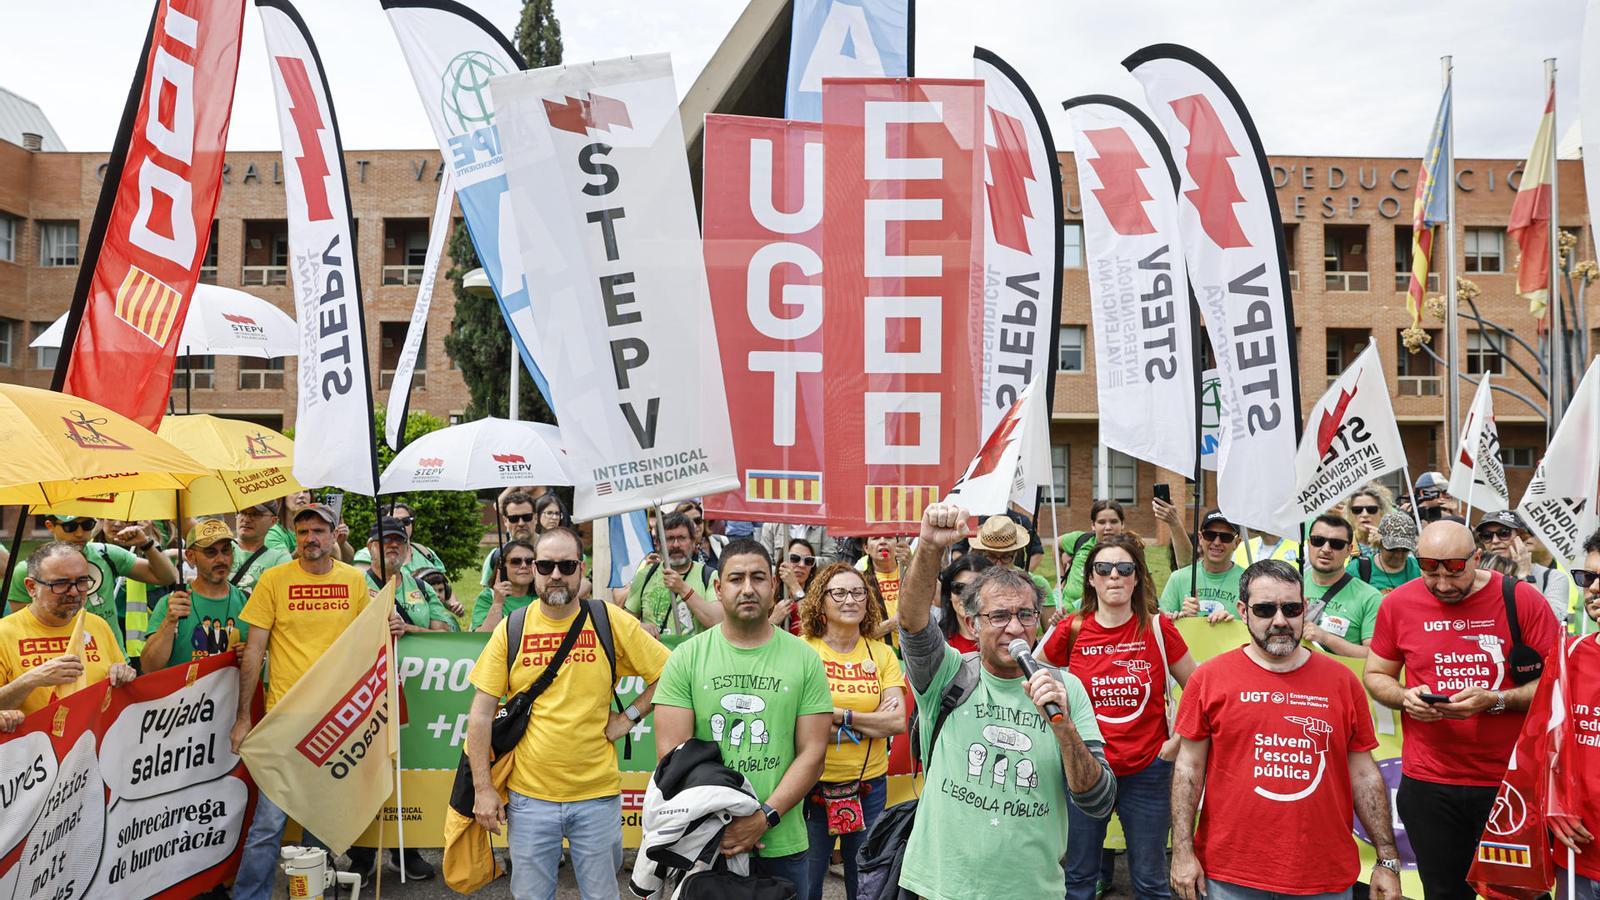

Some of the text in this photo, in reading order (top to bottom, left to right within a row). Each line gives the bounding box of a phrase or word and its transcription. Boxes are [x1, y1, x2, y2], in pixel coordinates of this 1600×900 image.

[1294, 195, 1400, 219] ESPO
[864, 101, 943, 465] CCOO
[577, 142, 660, 450] STEPV
[747, 138, 824, 447] UGT
[231, 324, 264, 333] STEPV
[498, 464, 532, 472] STEPV
[592, 448, 708, 481] INTERSINDICAL
[614, 462, 709, 492] VALENCIANA
[1524, 501, 1576, 561] LENCIANA
[291, 587, 331, 598] CCOO
[1197, 587, 1237, 603] STIMEM
[288, 600, 349, 611] educació
[1424, 620, 1451, 631] UGT
[522, 649, 597, 667] eduació
[1081, 645, 1104, 655] UGT
[1434, 652, 1488, 663] Salvem
[1435, 664, 1489, 676] l'escola
[712, 674, 782, 692] ESTIMEM
[829, 682, 880, 694] ucació
[1091, 675, 1136, 686] Salvem
[1437, 678, 1489, 691] pública
[1092, 685, 1139, 697] l'escola
[1240, 692, 1270, 702] UGT
[1289, 692, 1329, 702] Ensenyament
[1095, 697, 1138, 708] pública
[140, 692, 214, 744] pujada
[974, 703, 1047, 733] ESTIMEM
[1254, 733, 1311, 748] Salvem
[130, 733, 215, 785] salarial
[1255, 747, 1312, 764] l'escola
[1254, 763, 1310, 780] pública
[0, 754, 48, 809] ures
[941, 778, 999, 812] L'ESCOLA
[117, 798, 227, 849] sobrecàrrega
[29, 802, 84, 866] alumnat
[109, 826, 227, 885] de burocràcia
[30, 850, 67, 898] molt
